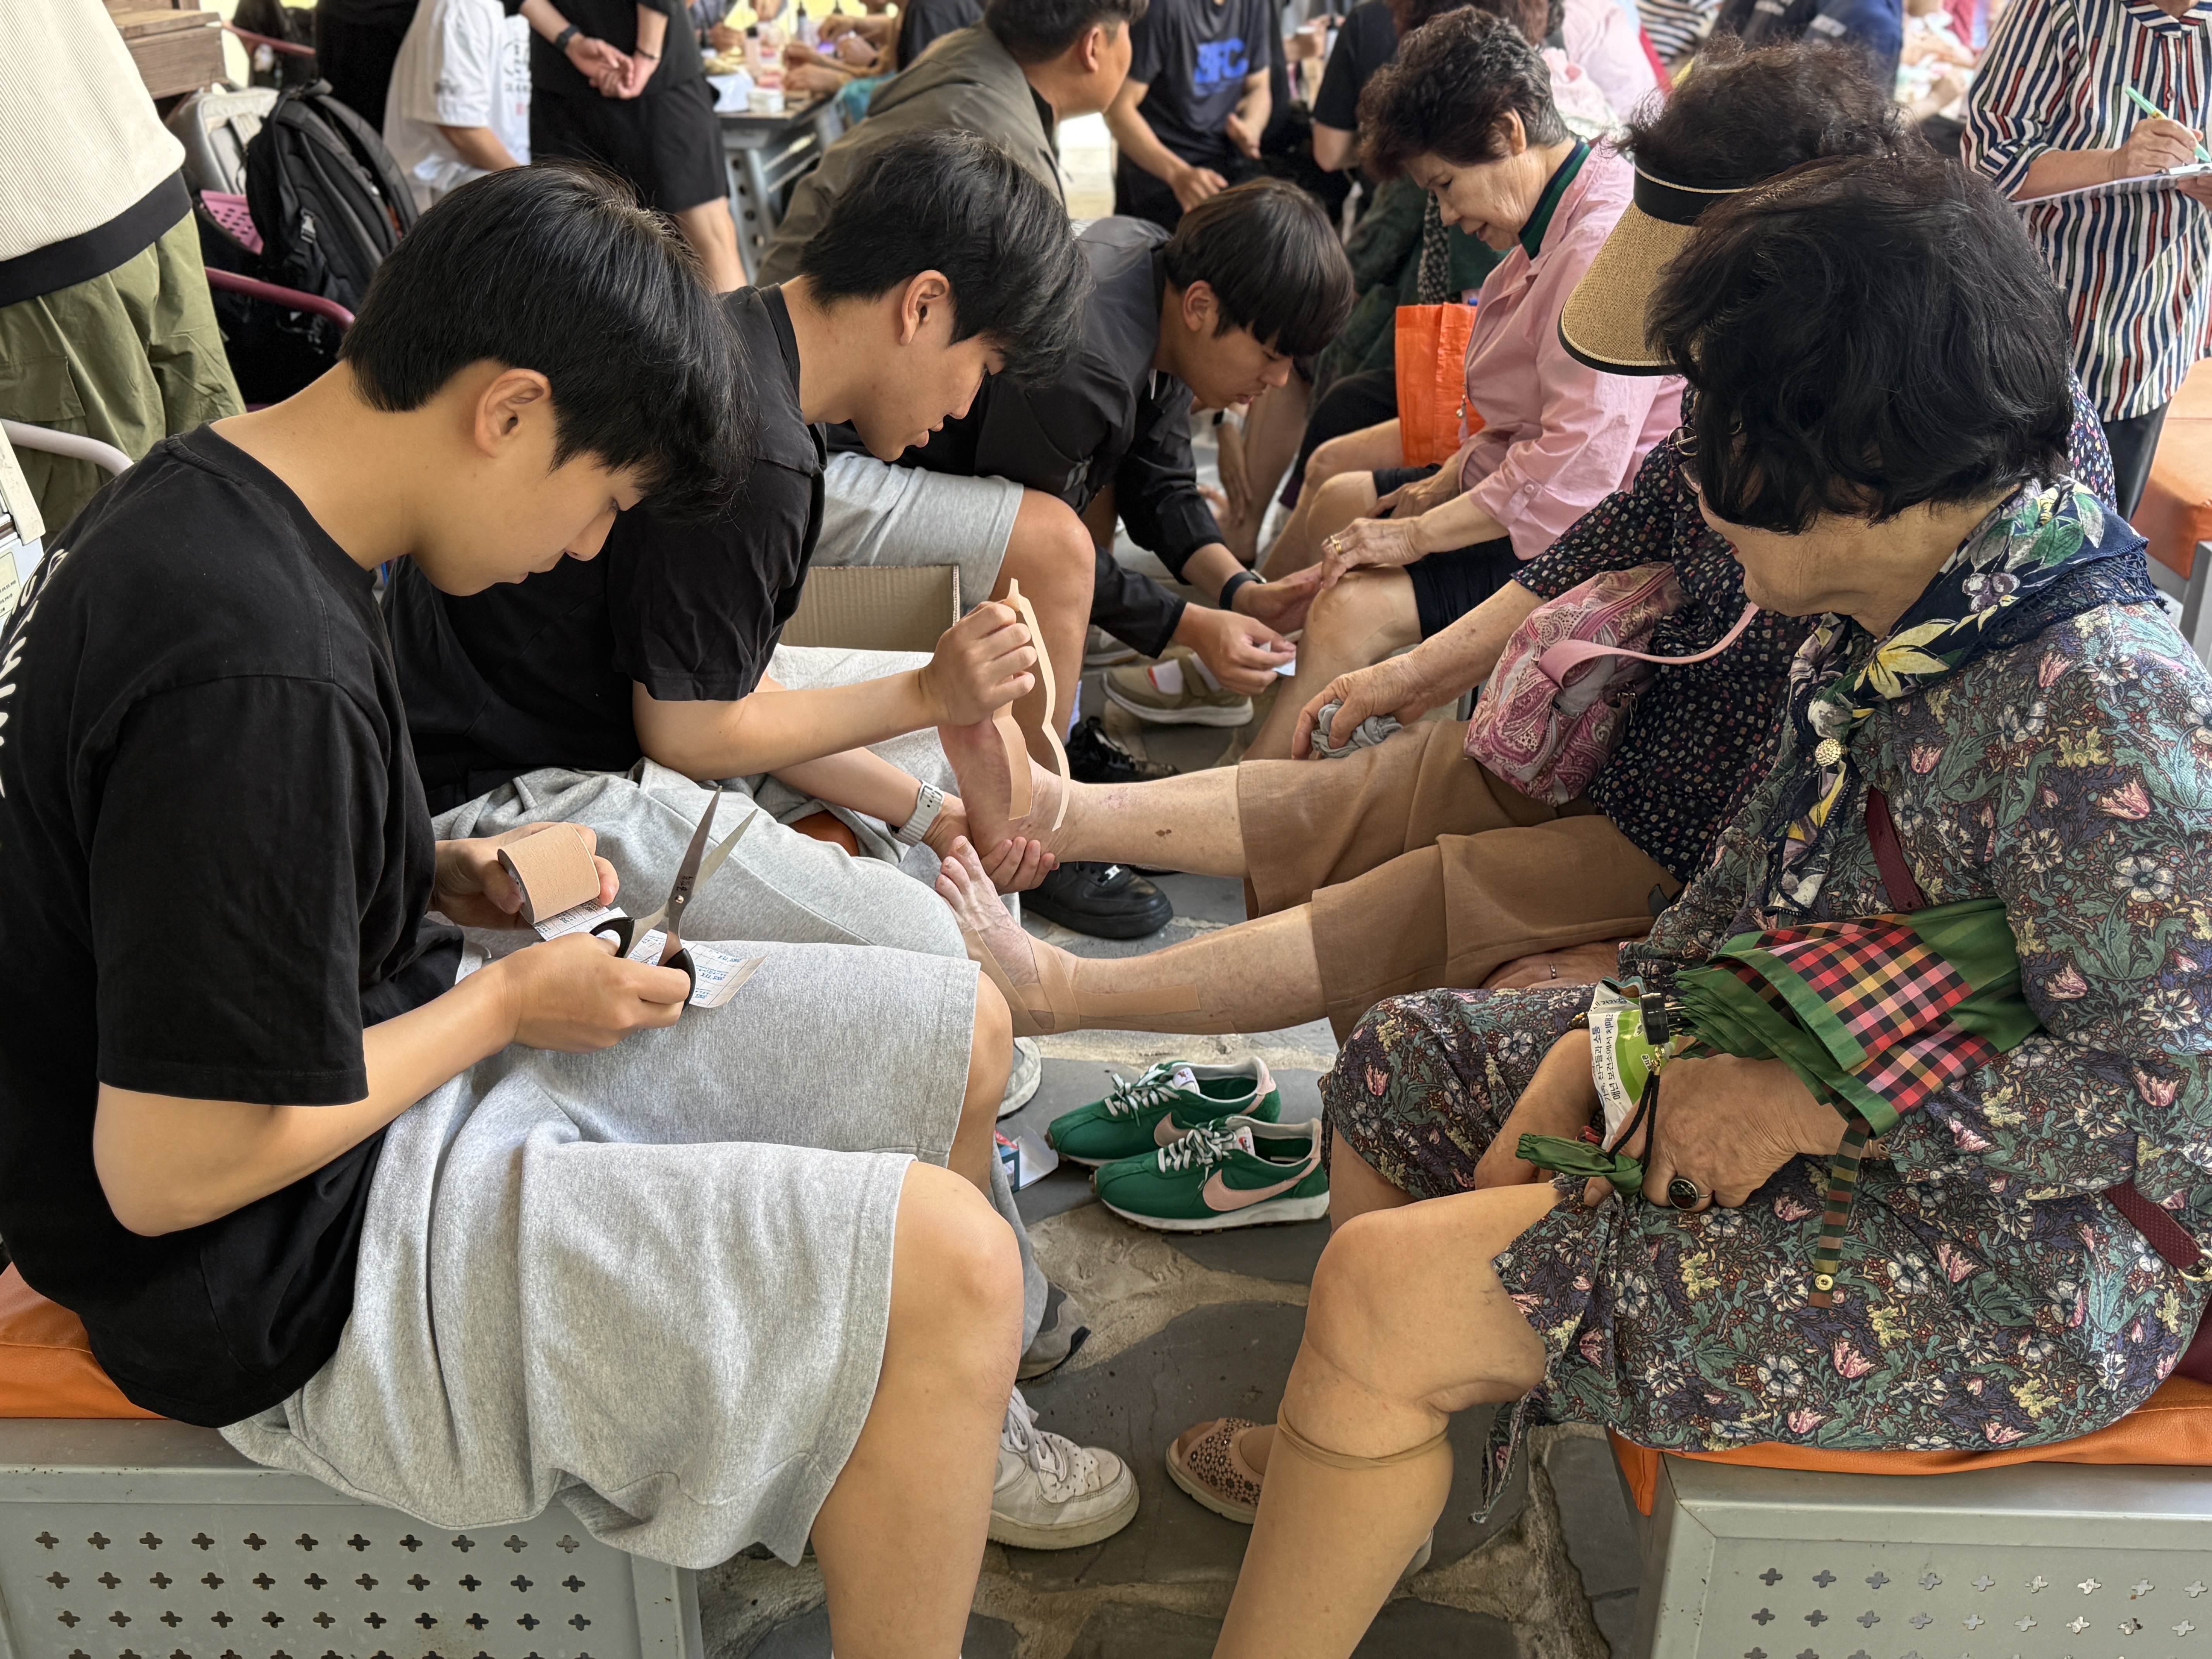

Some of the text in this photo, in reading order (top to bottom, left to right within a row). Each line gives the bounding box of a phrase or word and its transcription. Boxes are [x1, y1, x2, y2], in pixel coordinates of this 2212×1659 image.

[1592, 1026, 1601, 1044] 소통
[1595, 1046, 1604, 1080] 친구들과
[1606, 1036, 1615, 1080] 보건소에서
[1609, 1082, 1621, 1100] 매년
